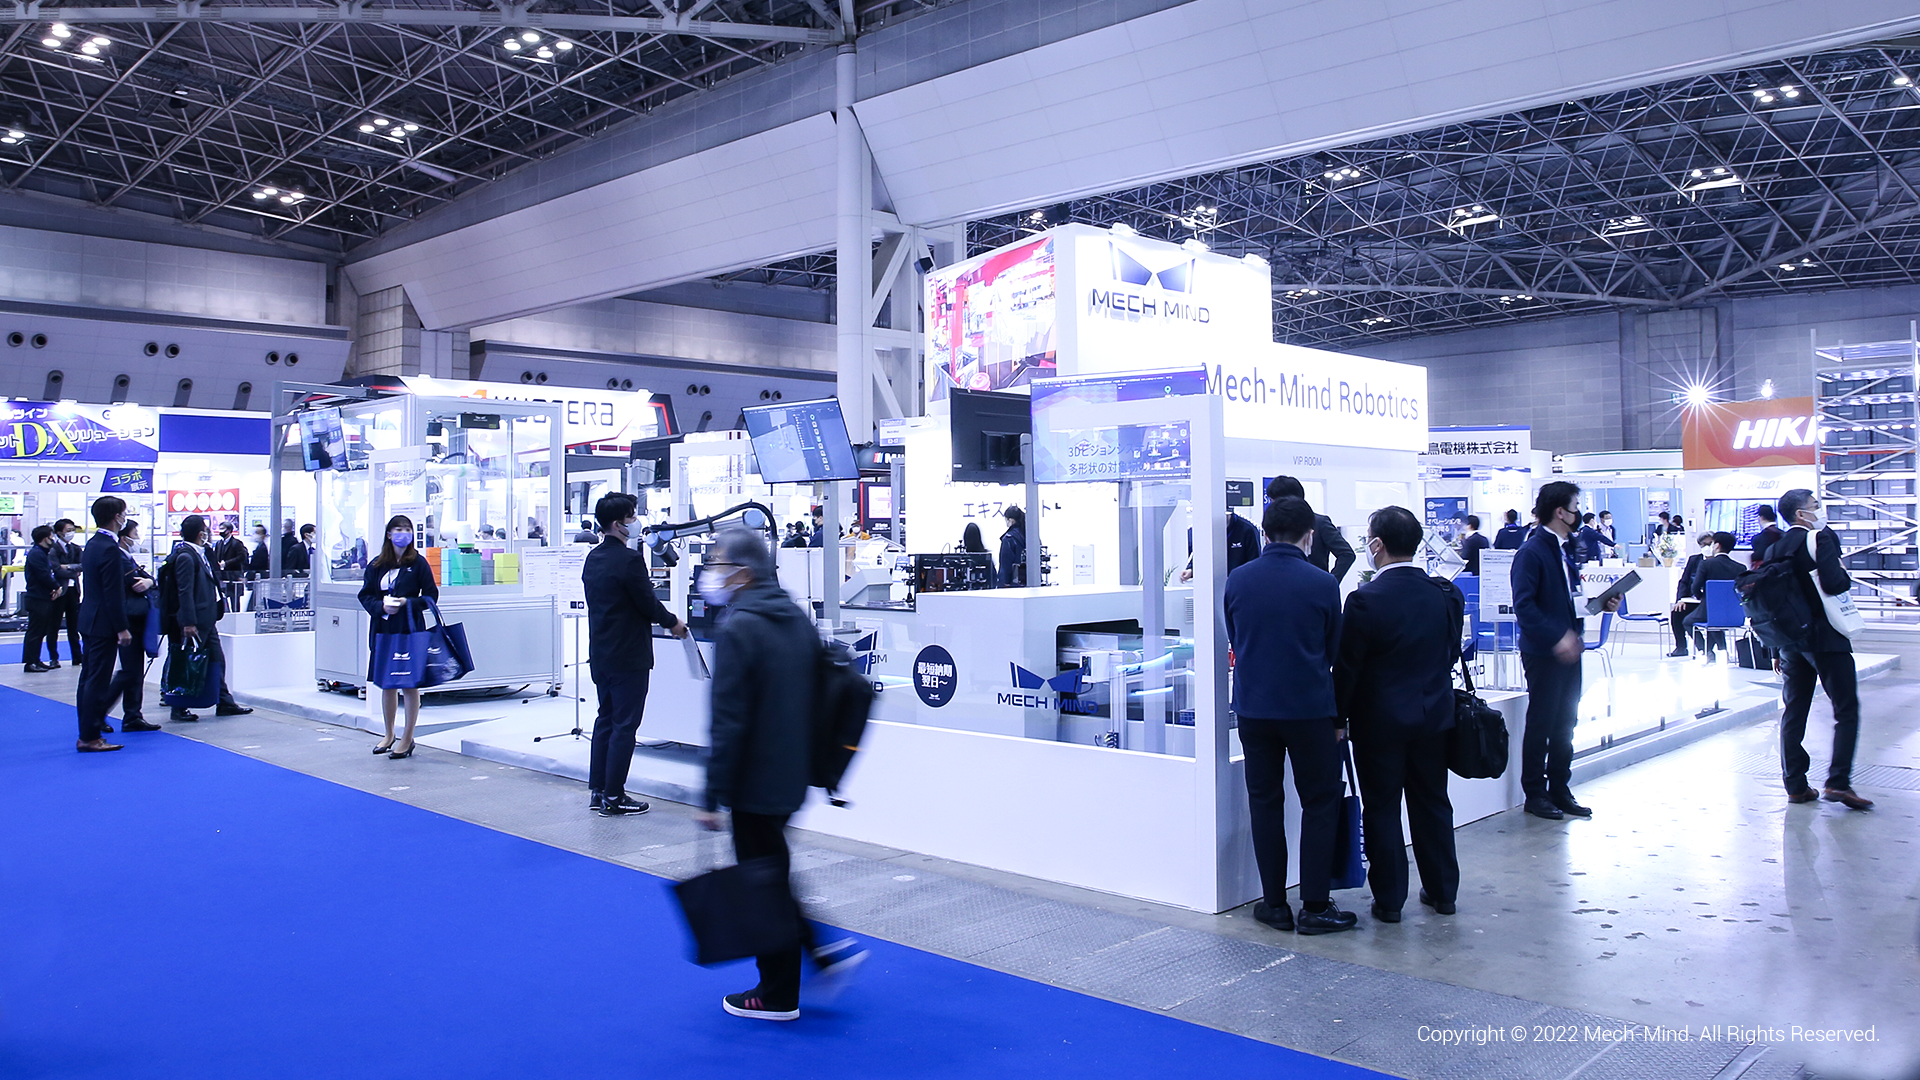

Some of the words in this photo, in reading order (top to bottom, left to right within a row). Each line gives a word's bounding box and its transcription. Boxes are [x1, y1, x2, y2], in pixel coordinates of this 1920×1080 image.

[1093, 288, 1156, 315] MECH
[1165, 301, 1210, 323] MIND
[1201, 362, 1331, 411] Mech-Mind
[1339, 381, 1418, 420] Robotics
[0, 407, 48, 420] ツイン
[8, 419, 82, 458] DX
[67, 427, 155, 443] ソリューション
[1418, 441, 1519, 455] 鳥電機株式会社
[1292, 456, 1303, 465] VIP
[1304, 457, 1322, 466] ROOM
[38, 475, 91, 484] FANUC
[110, 470, 143, 486] コラボ
[255, 611, 287, 619] MECH
[917, 661, 953, 678] 最短納期
[997, 693, 1048, 709] MECH
[1054, 698, 1099, 714] MIND
